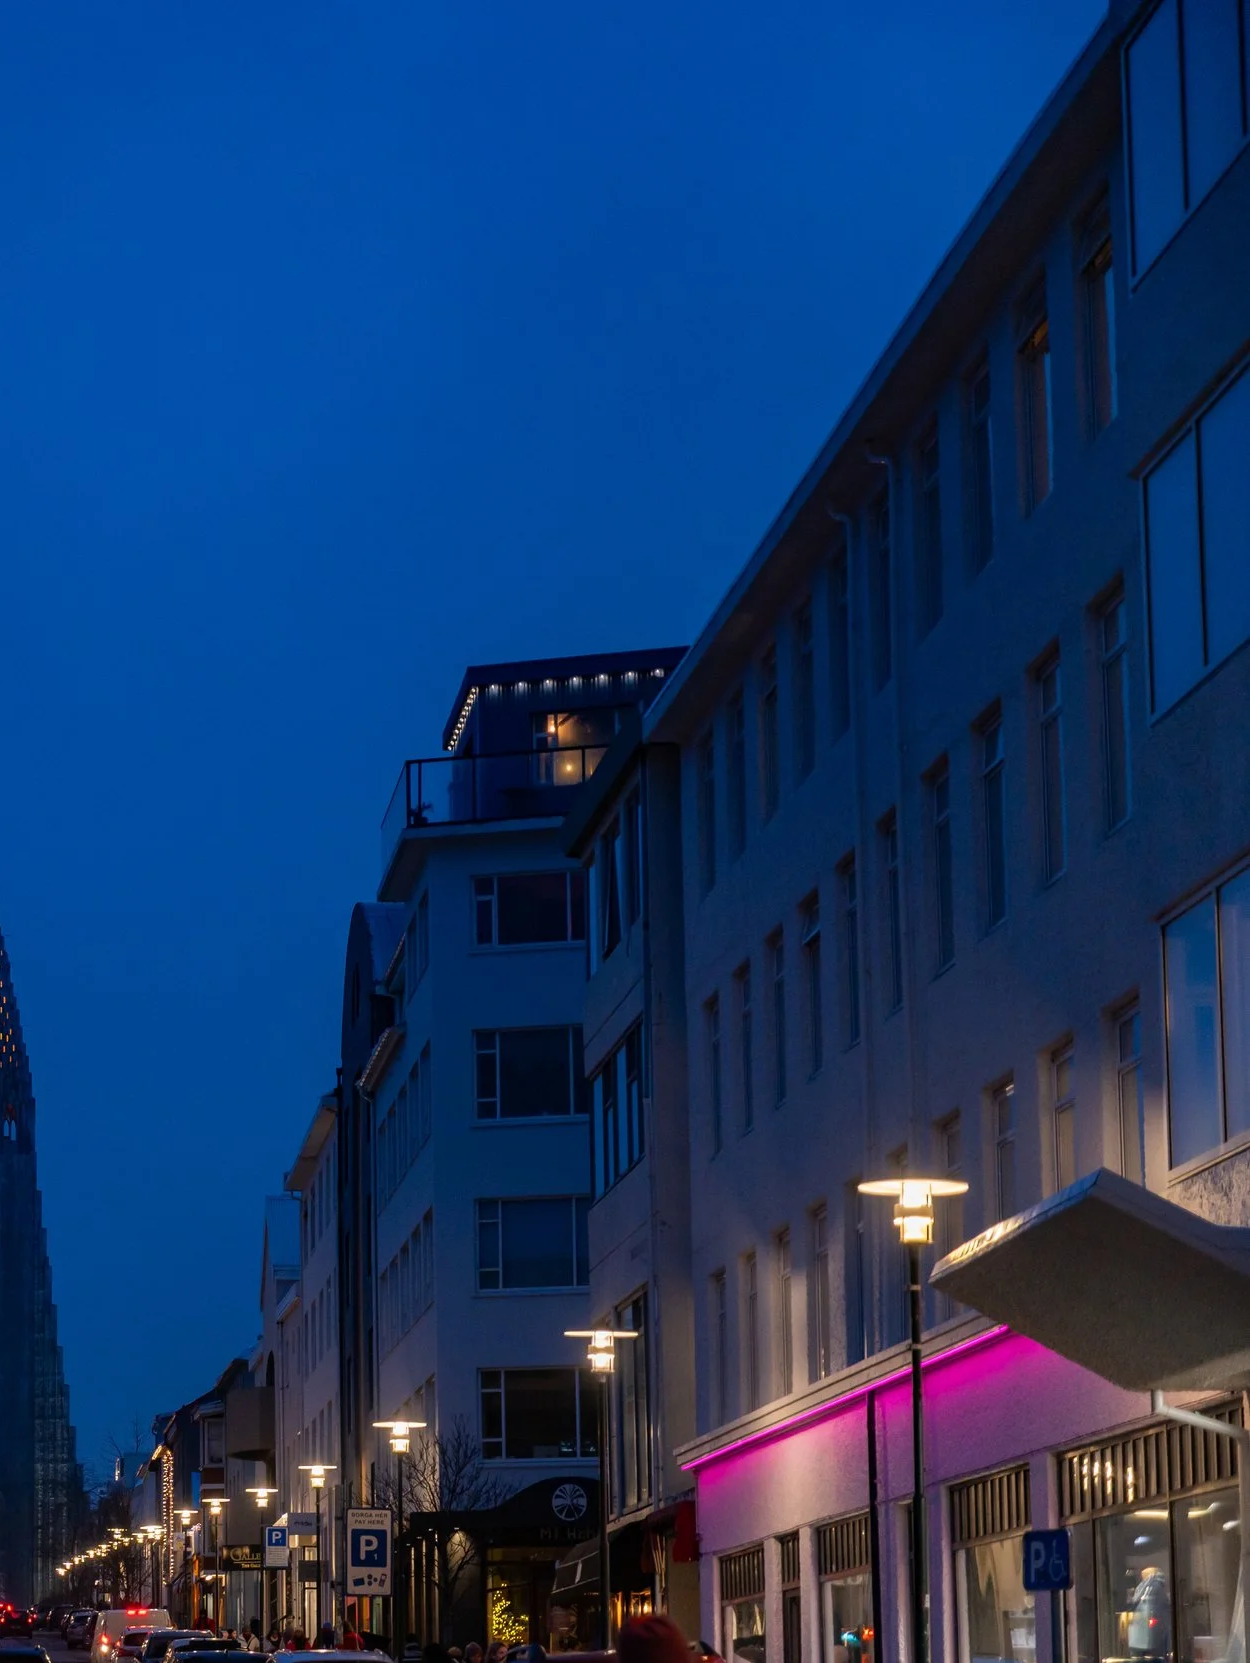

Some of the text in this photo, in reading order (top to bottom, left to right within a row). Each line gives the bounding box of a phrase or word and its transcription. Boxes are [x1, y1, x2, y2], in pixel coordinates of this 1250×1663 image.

[271, 1531, 283, 1544] P
[359, 1534, 379, 1560] P
[1030, 1540, 1046, 1584] P
